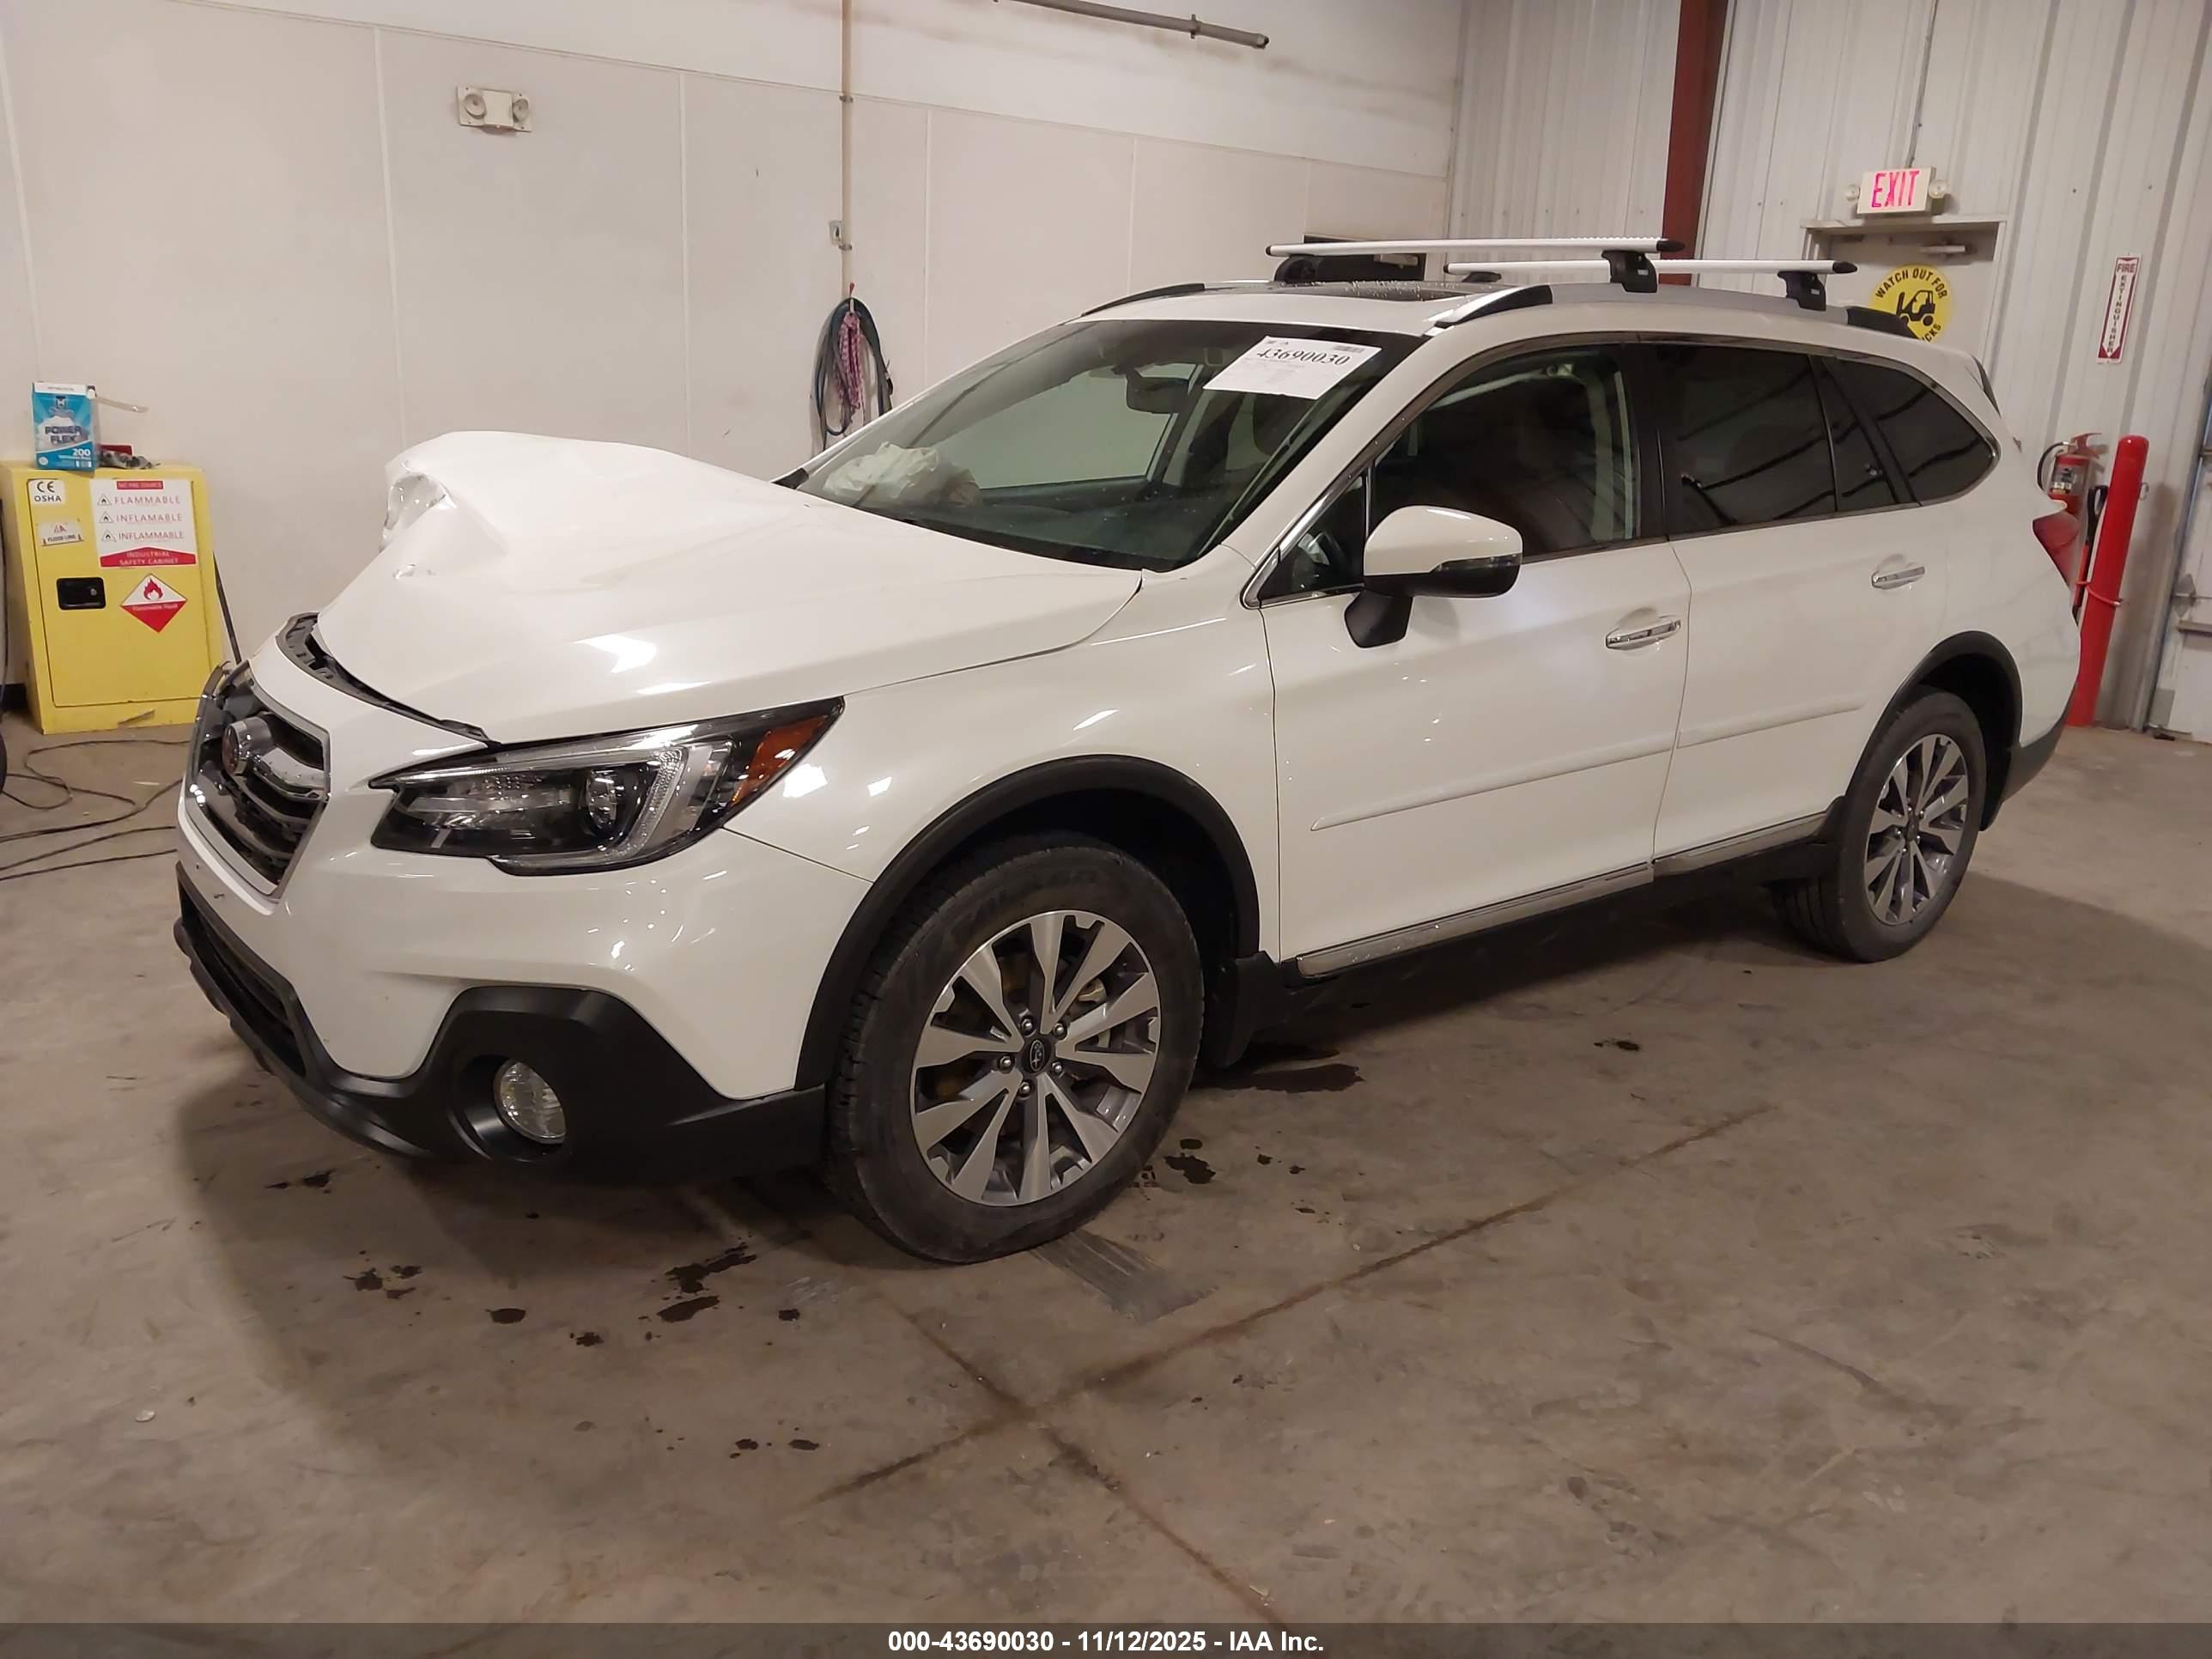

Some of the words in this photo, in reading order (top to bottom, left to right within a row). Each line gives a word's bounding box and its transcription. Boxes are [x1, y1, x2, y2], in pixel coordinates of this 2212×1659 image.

[1872, 170, 1920, 207] EXIT
[2116, 263, 2136, 273] FIRE
[1875, 270, 1909, 299] WATCH
[1912, 268, 1934, 281] OUT
[1930, 276, 1948, 299] FOR
[1256, 348, 1352, 366] 43690030
[45, 425, 82, 434] POWER
[50, 434, 77, 444] FLEX
[114, 495, 181, 504] FLAMMABLE
[116, 514, 183, 522] INFLAMABLE
[118, 531, 185, 540] INFLAMMABLE
